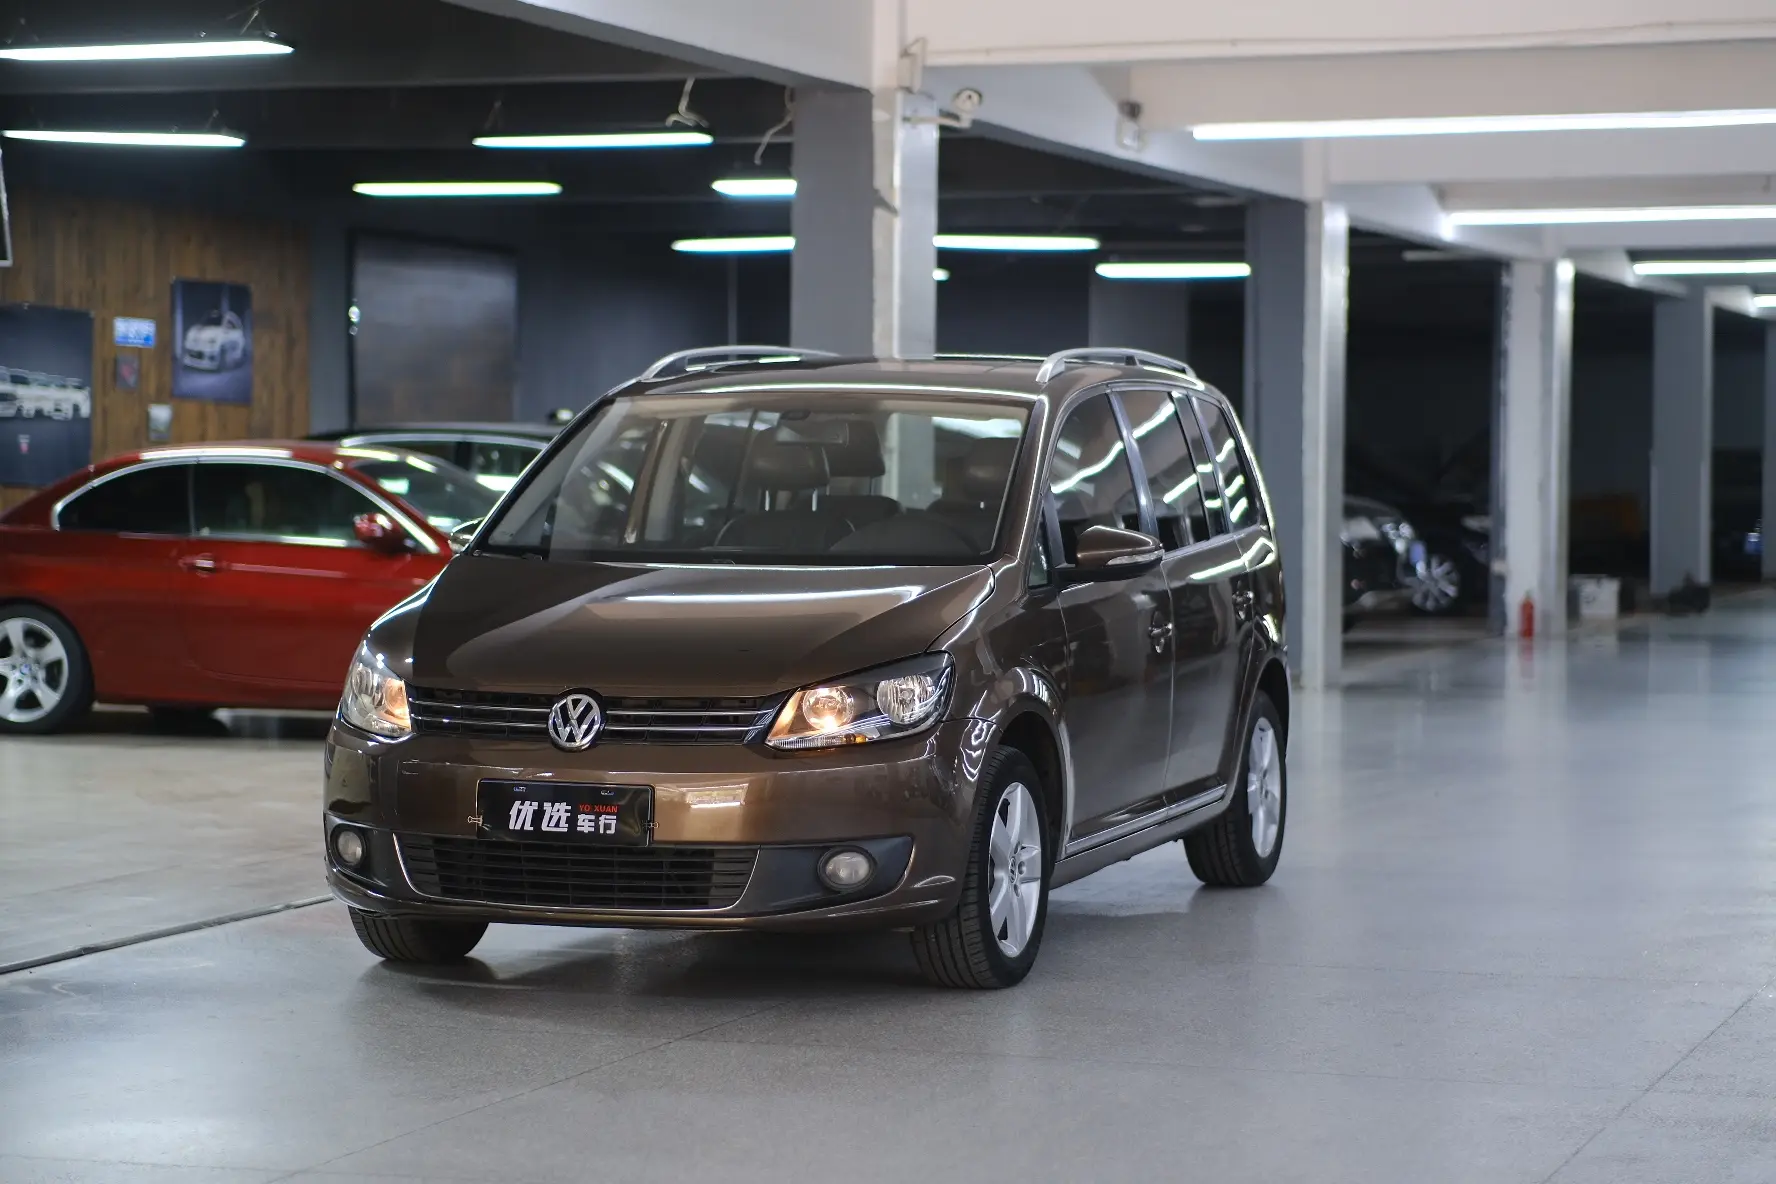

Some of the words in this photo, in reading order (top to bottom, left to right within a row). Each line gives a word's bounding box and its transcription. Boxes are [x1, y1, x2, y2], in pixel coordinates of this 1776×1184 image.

[508, 800, 572, 832] 优选
[579, 804, 591, 812] YO
[594, 805, 618, 813] XUAN
[576, 813, 617, 834] 车行
